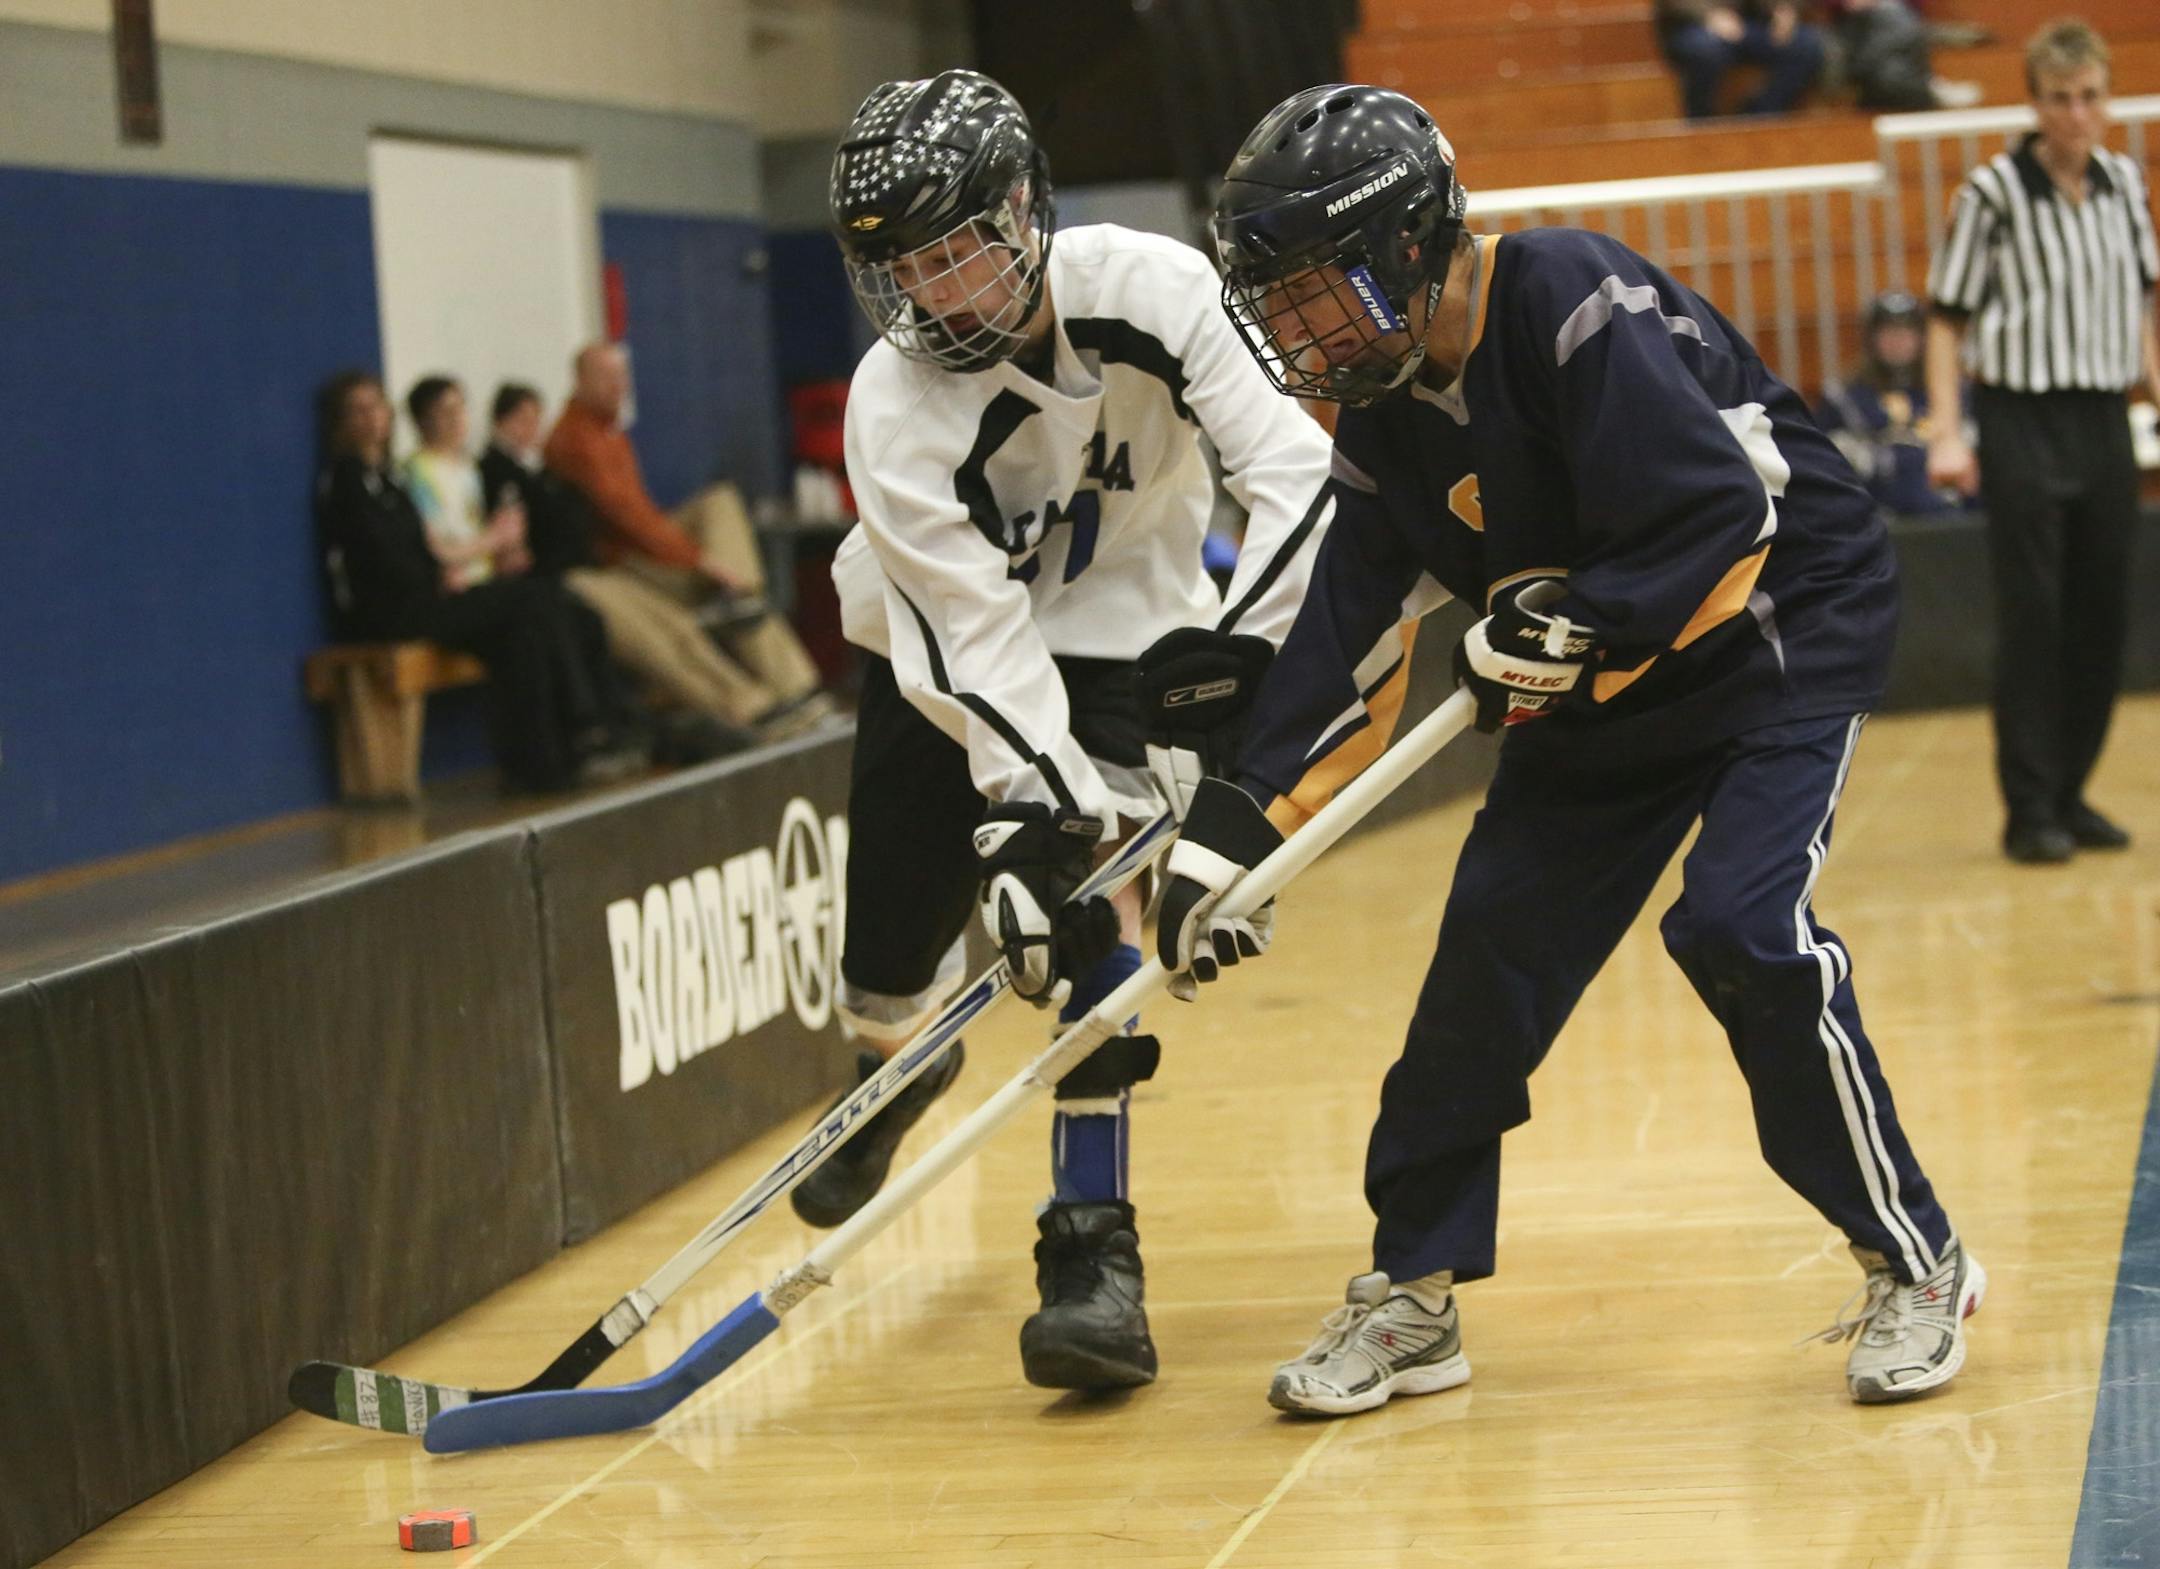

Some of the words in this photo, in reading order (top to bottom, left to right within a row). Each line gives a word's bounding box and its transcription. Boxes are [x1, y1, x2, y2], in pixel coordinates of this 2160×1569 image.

[1326, 163, 1408, 218] MISSION
[1351, 275, 1392, 330] BAUER
[1501, 671, 1565, 687] MYLEC
[1510, 694, 1544, 705] STREET
[606, 846, 787, 1092] BORDER
[793, 1056, 908, 1173] ELITE
